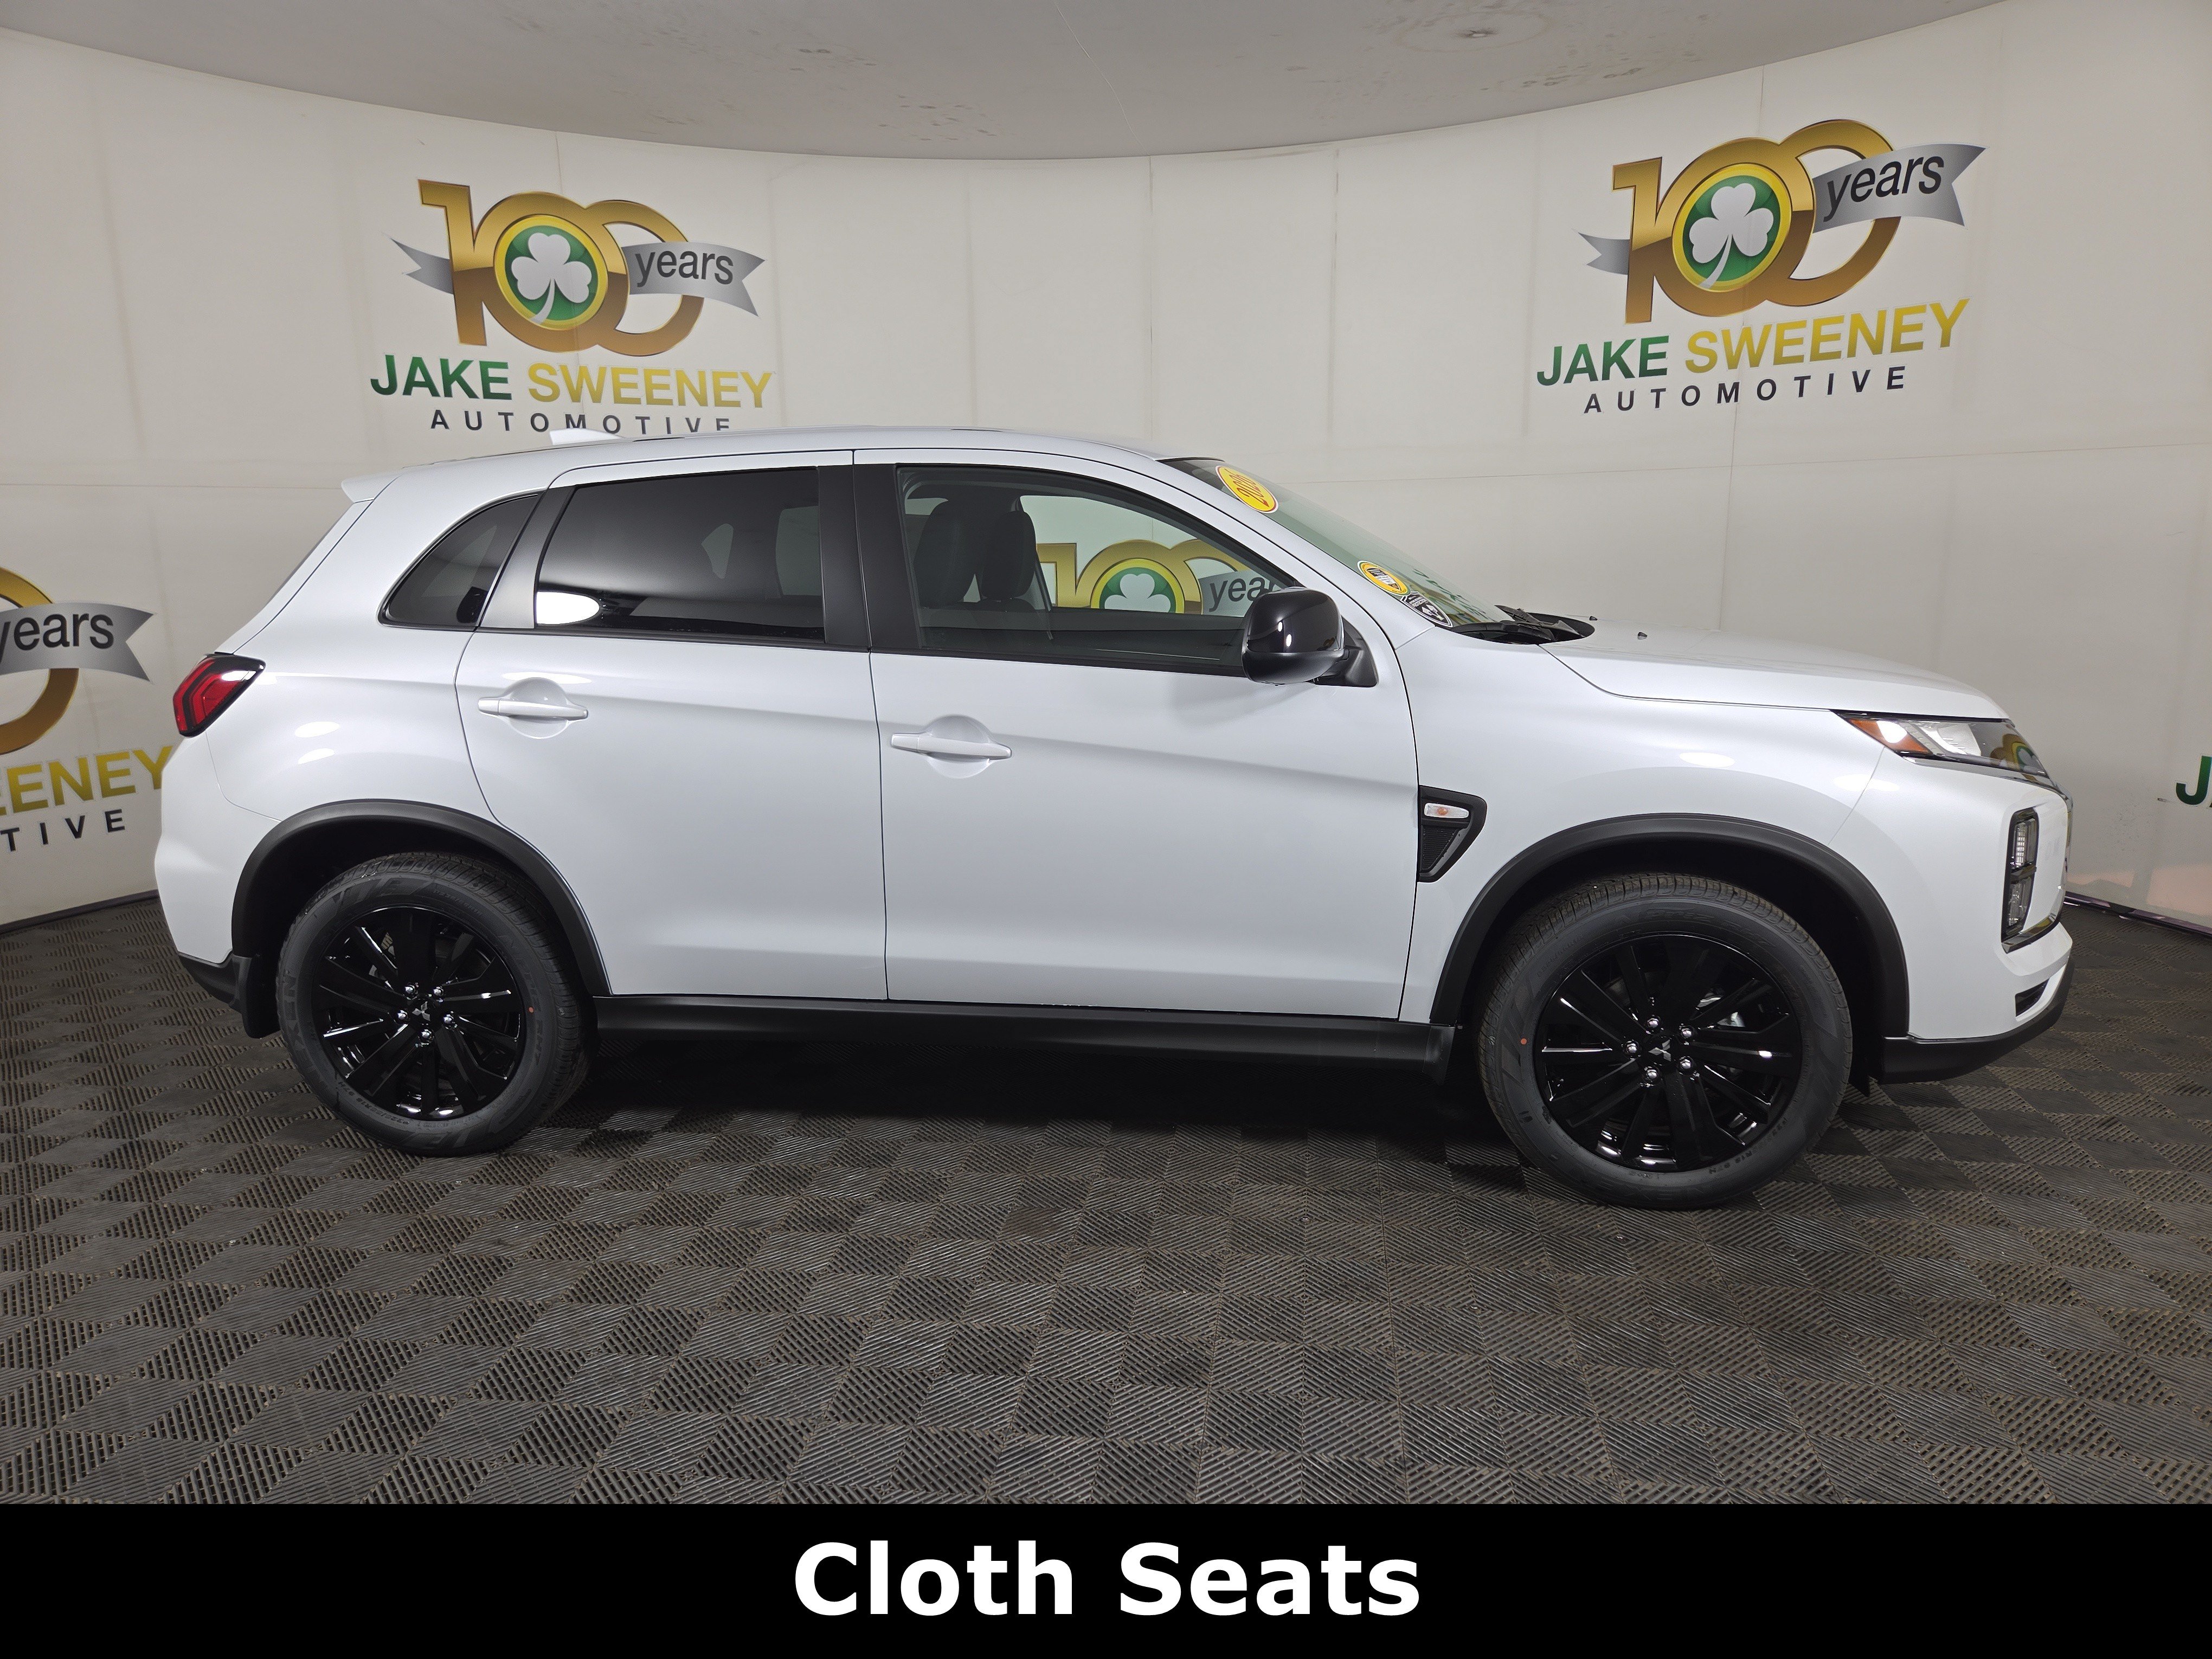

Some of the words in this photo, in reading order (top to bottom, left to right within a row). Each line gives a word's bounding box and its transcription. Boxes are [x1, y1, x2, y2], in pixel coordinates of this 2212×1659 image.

[1823, 156, 1944, 222] years
[635, 250, 734, 288] years
[1536, 335, 1669, 387] JAKE
[1684, 298, 1971, 374] SWEENEY
[370, 354, 512, 401] JAKE
[528, 362, 773, 408] SWEENEY
[1584, 366, 1907, 414] AUTOMOTIVE
[430, 409, 730, 435] AUTOMOTIVE
